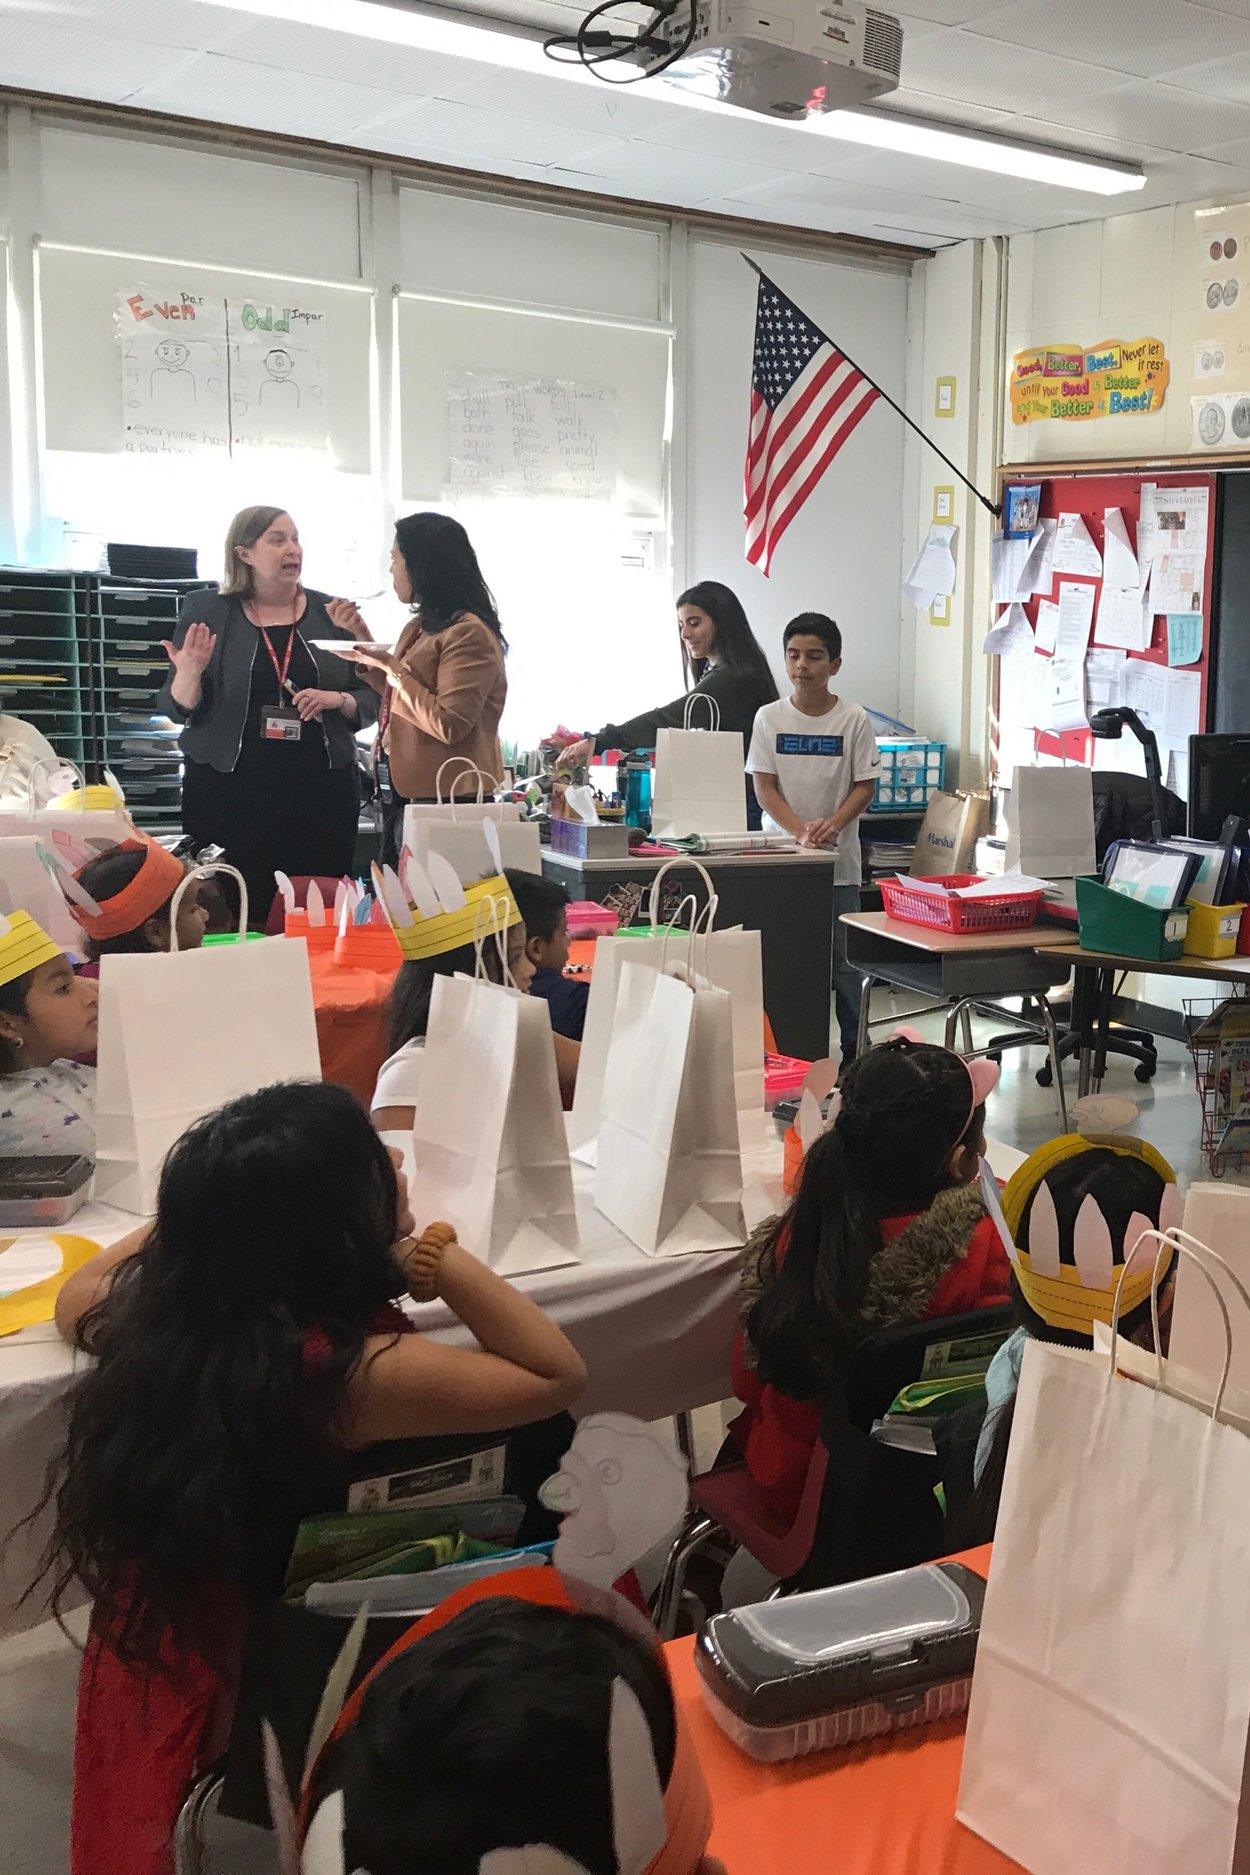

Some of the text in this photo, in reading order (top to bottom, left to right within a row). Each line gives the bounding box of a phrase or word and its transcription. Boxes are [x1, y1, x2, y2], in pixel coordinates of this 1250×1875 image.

[126, 294, 196, 322] Even
[241, 303, 324, 333] Odd Impar
[1047, 355, 1083, 374] Better,
[1086, 353, 1118, 372] Best.
[1121, 345, 1146, 361] Never
[1148, 343, 1160, 356] let
[1138, 359, 1164, 372] it rest
[1060, 378, 1090, 397] Good
[1104, 375, 1142, 390] Better
[1050, 387, 1154, 418] Better Best!
[1225, 920, 1233, 932] 2
